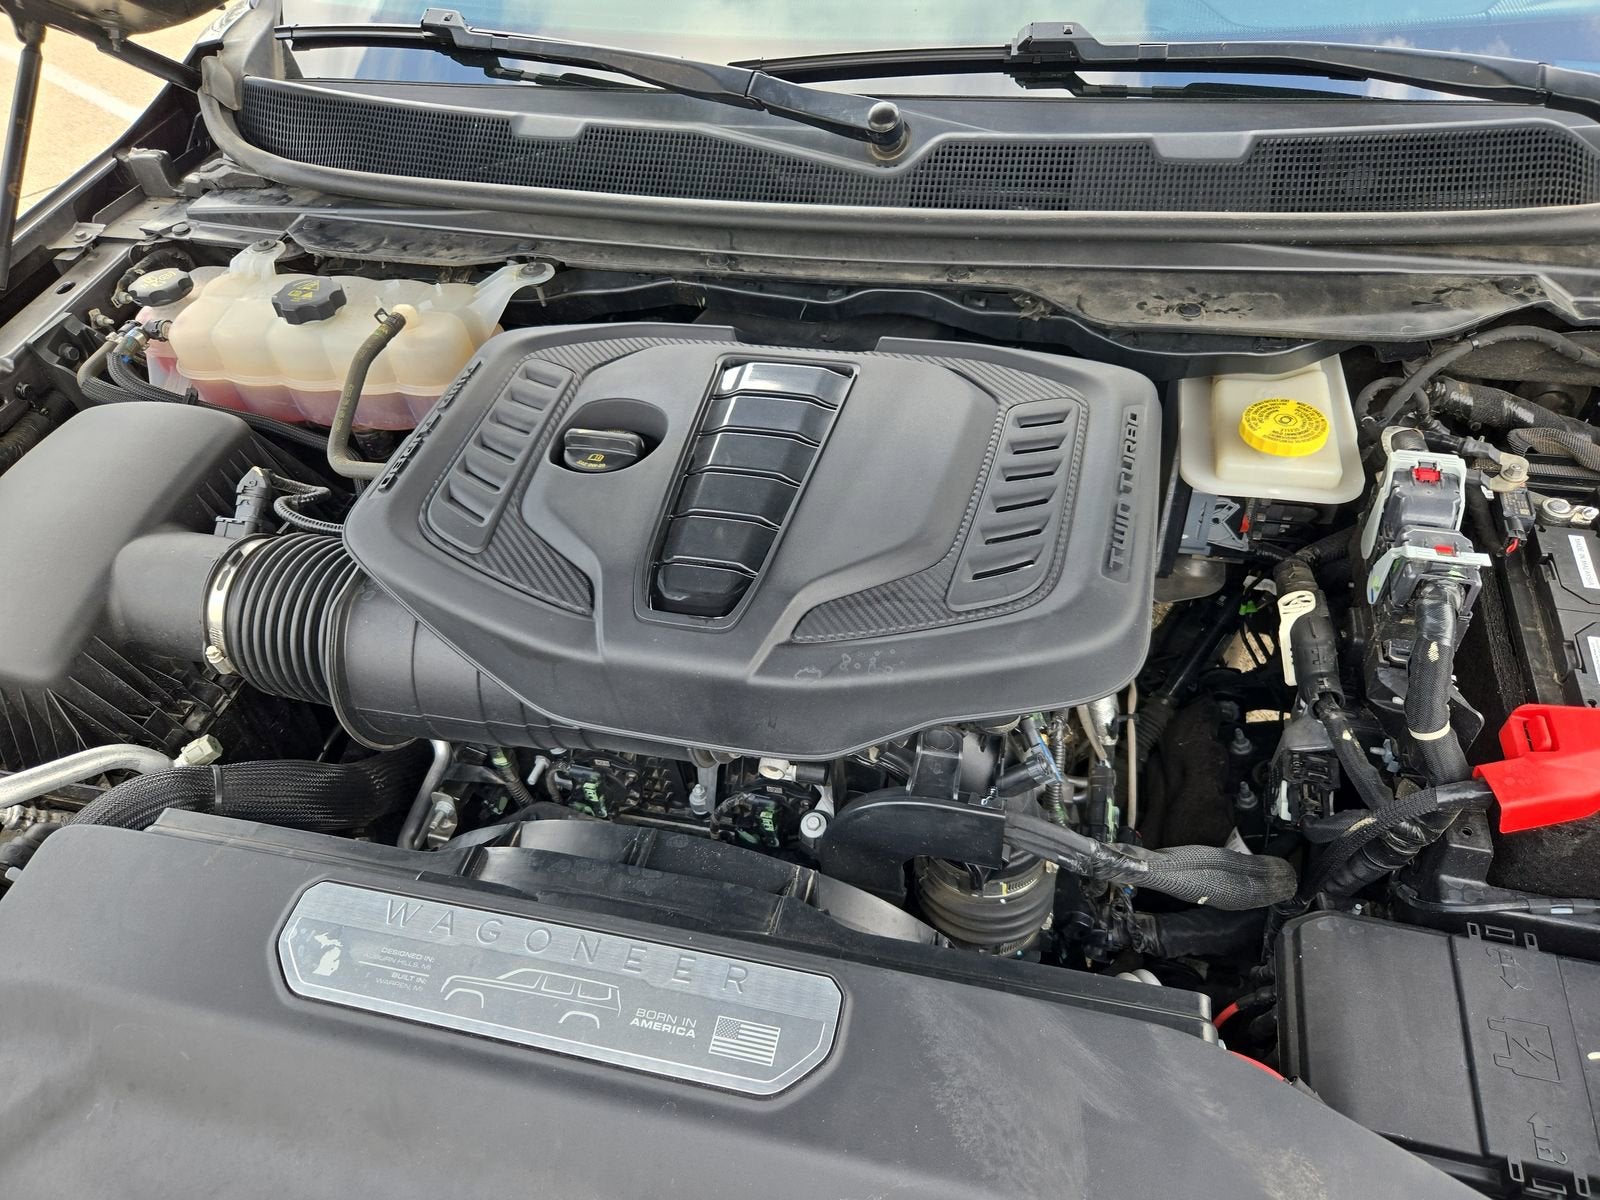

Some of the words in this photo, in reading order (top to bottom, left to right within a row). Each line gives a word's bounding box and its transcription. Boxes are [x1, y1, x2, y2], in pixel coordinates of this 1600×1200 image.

[1119, 410, 1139, 495] TURBO
[1108, 500, 1131, 572] TWIN
[380, 946, 423, 961] DESIGNED
[384, 898, 751, 995] WAGONEER
[391, 971, 416, 982] BUILT
[629, 1017, 696, 1039] AMERICA
[635, 1007, 678, 1025] BORN
[681, 1016, 697, 1029] IN
